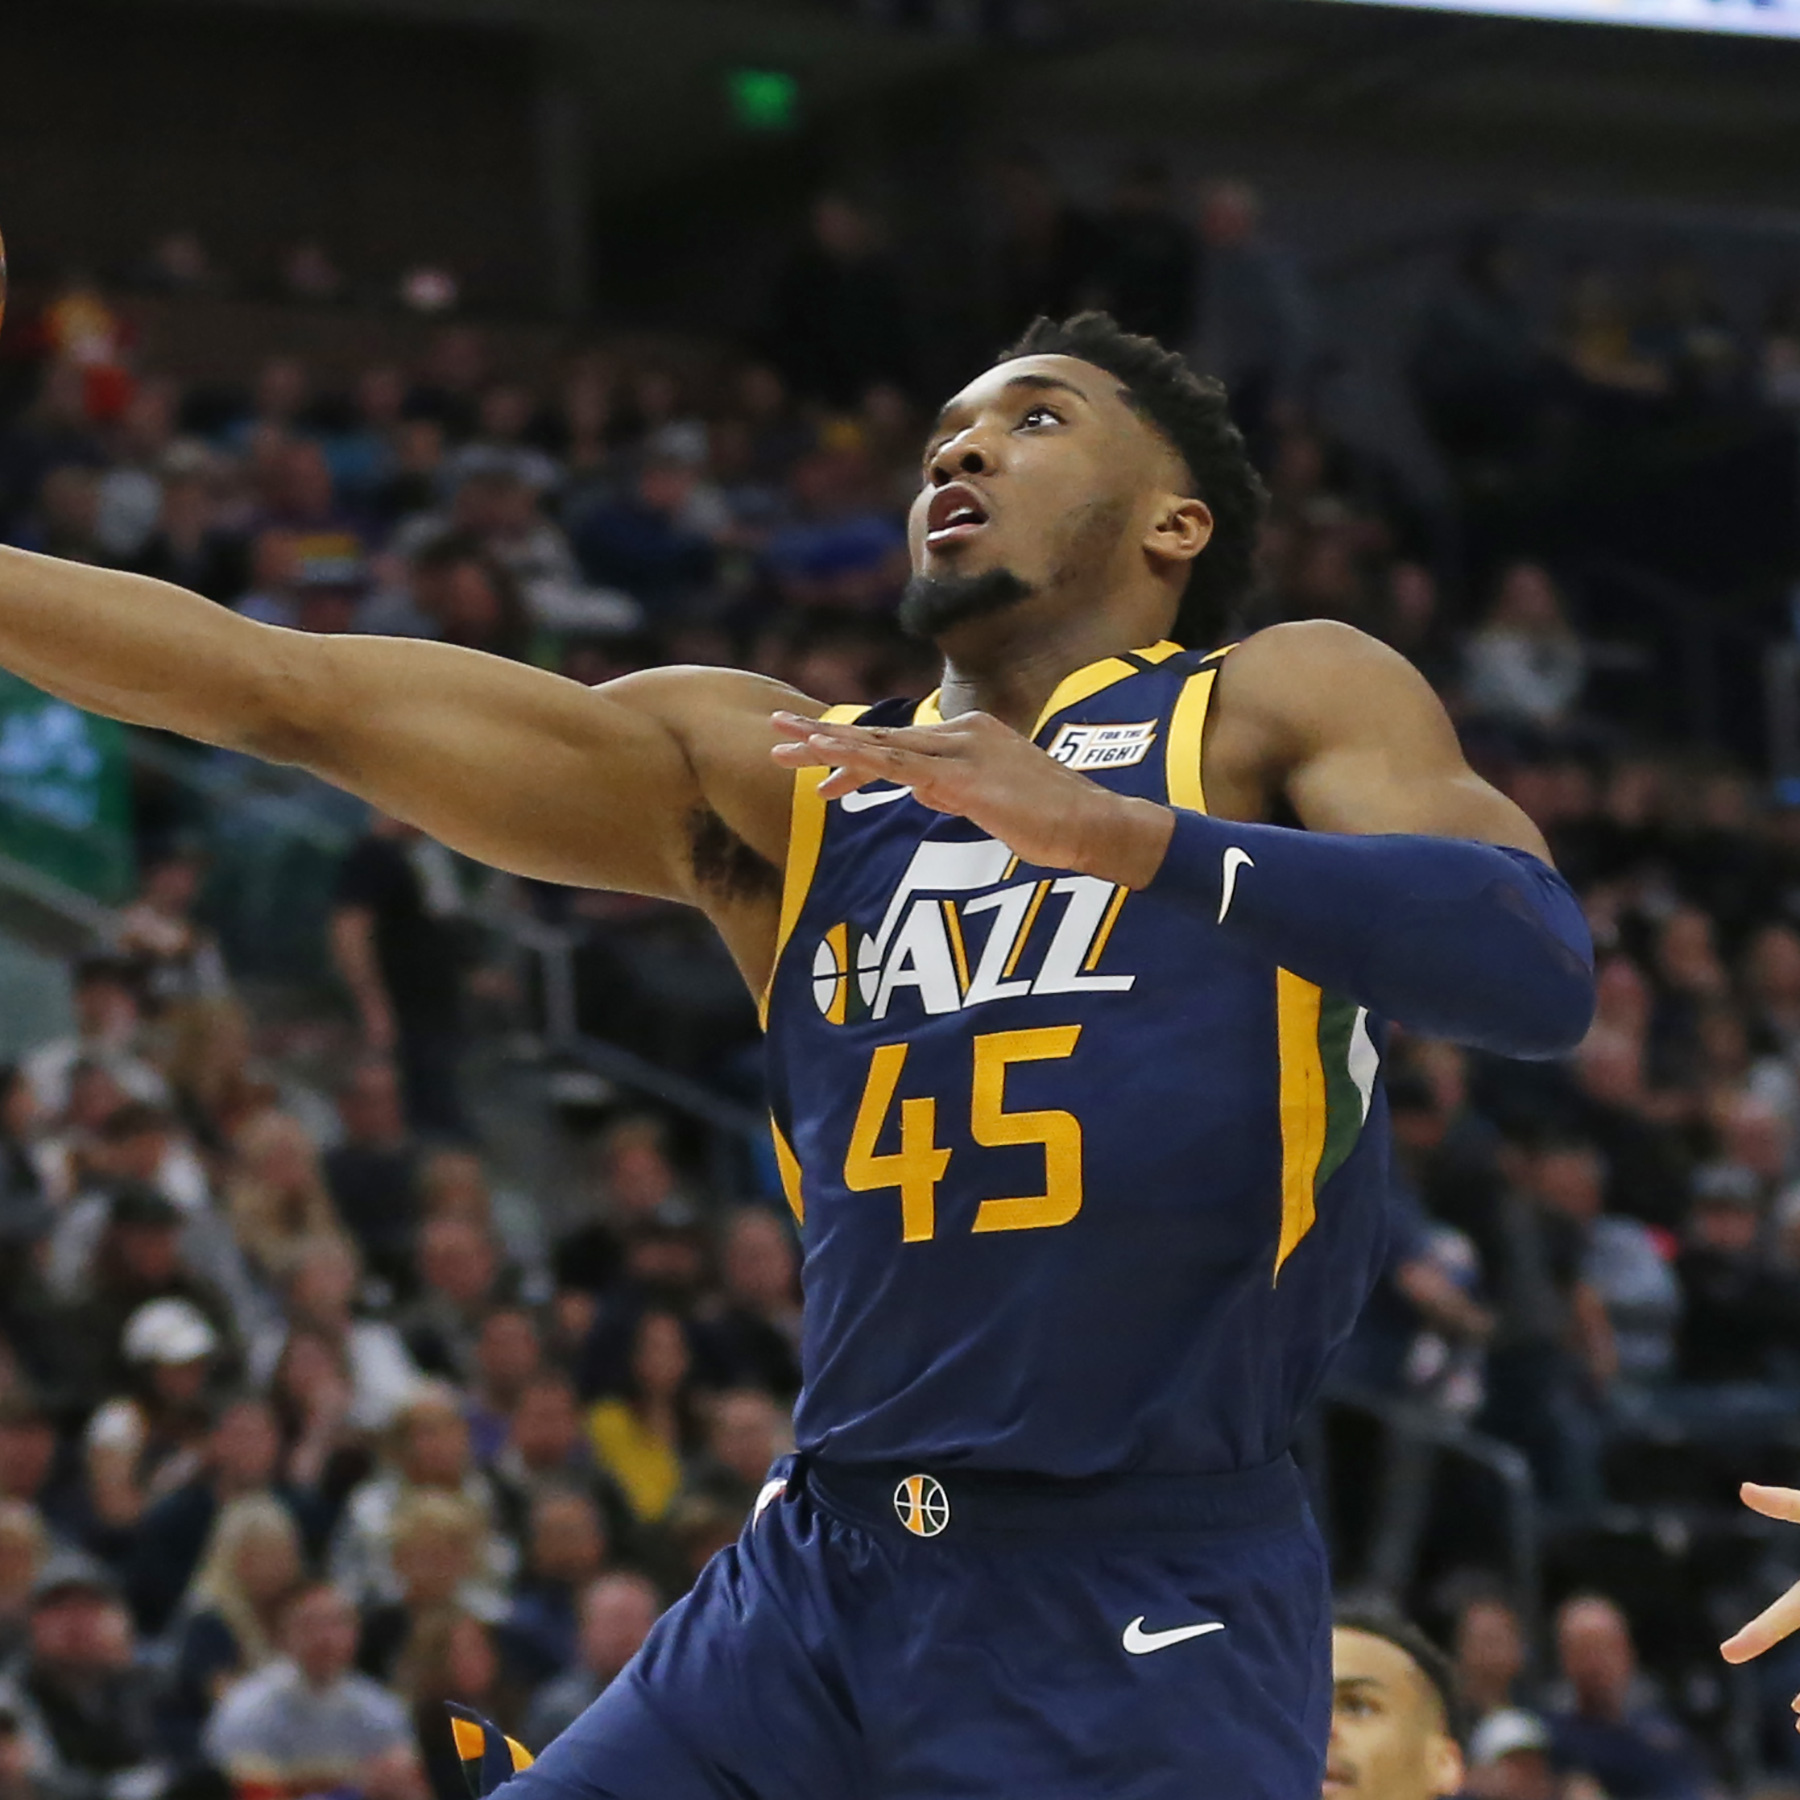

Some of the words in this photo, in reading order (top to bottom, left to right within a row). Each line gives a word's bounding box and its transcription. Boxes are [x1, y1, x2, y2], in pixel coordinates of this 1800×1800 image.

[1055, 731, 1088, 763] 5
[1099, 731, 1121, 740] FOR
[1123, 729, 1146, 739] THE
[1082, 743, 1145, 764] FIGHT
[843, 1024, 1085, 1244] 45
